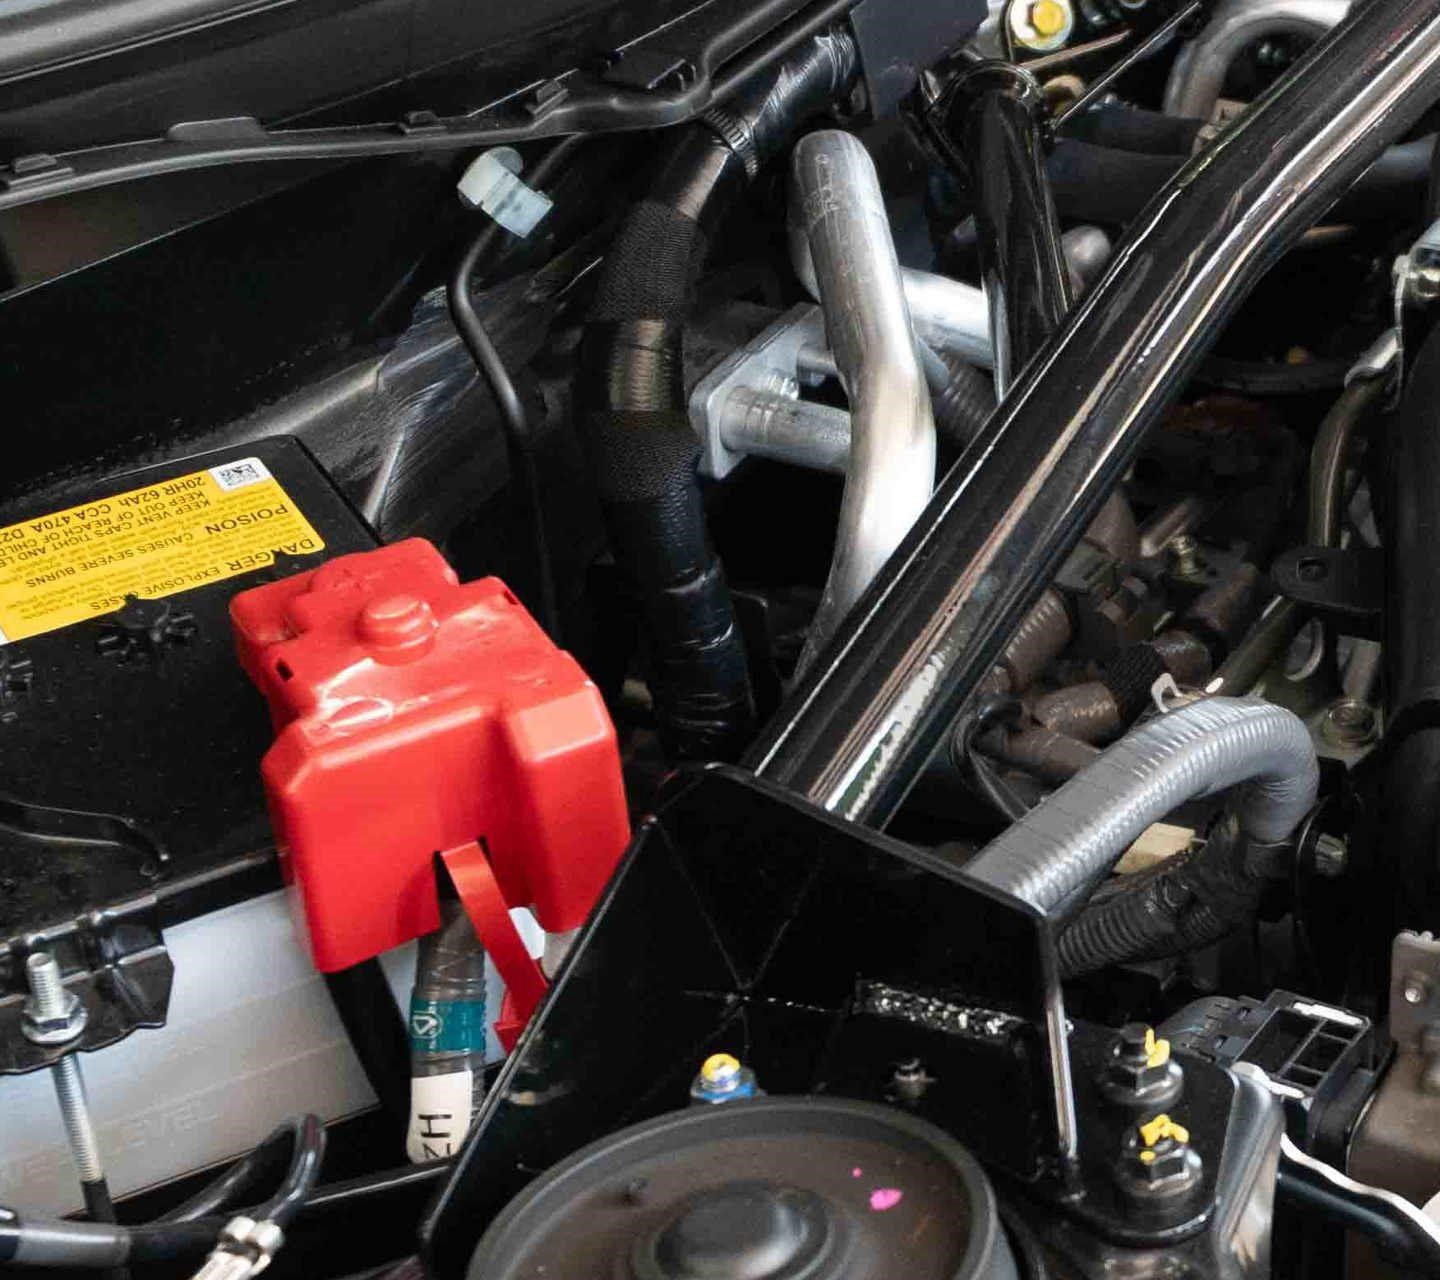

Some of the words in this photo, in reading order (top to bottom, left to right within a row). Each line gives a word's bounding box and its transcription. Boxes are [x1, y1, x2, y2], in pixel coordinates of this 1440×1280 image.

[160, 476, 205, 495] 20HR
[117, 489, 161, 508] 62Ah
[166, 489, 205, 506] KEEP
[172, 498, 212, 515] KEEP
[73, 502, 112, 521] CCA
[134, 509, 172, 526] VENT
[137, 501, 166, 515] OUT
[29, 514, 72, 534] 470A
[62, 516, 111, 537] REACH
[203, 503, 288, 535] POISON
[93, 521, 133, 538] CAPS
[50, 533, 91, 550] TIGHT
[135, 531, 194, 555] CAUSES
[15, 546, 48, 561] AND
[77, 548, 134, 571] SEVERE
[24, 565, 77, 588] BURNS
[142, 566, 221, 595] EXPLOSIVE
[89, 589, 140, 611] SES
